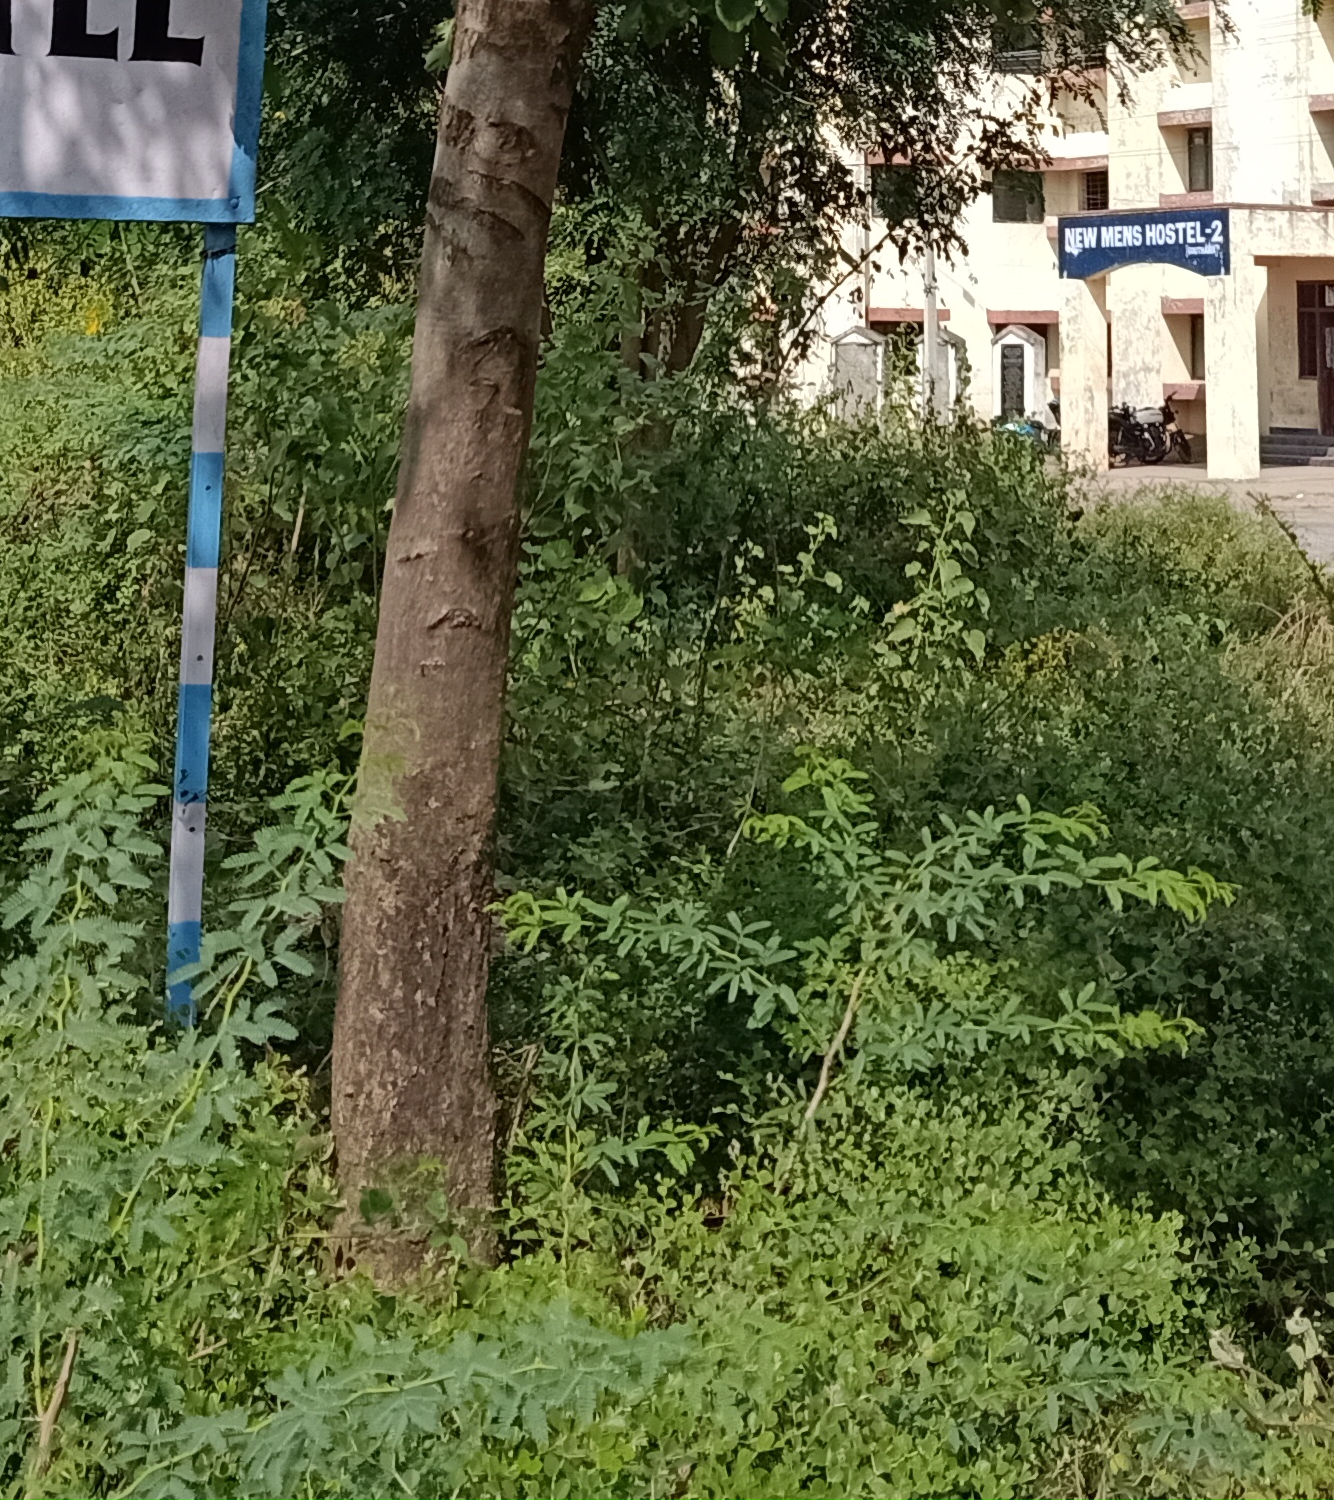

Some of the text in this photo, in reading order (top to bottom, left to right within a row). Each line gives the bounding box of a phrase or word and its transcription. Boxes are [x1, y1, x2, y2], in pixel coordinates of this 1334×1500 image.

[1064, 219, 1224, 251] NEW MENS HOSTEL-2
